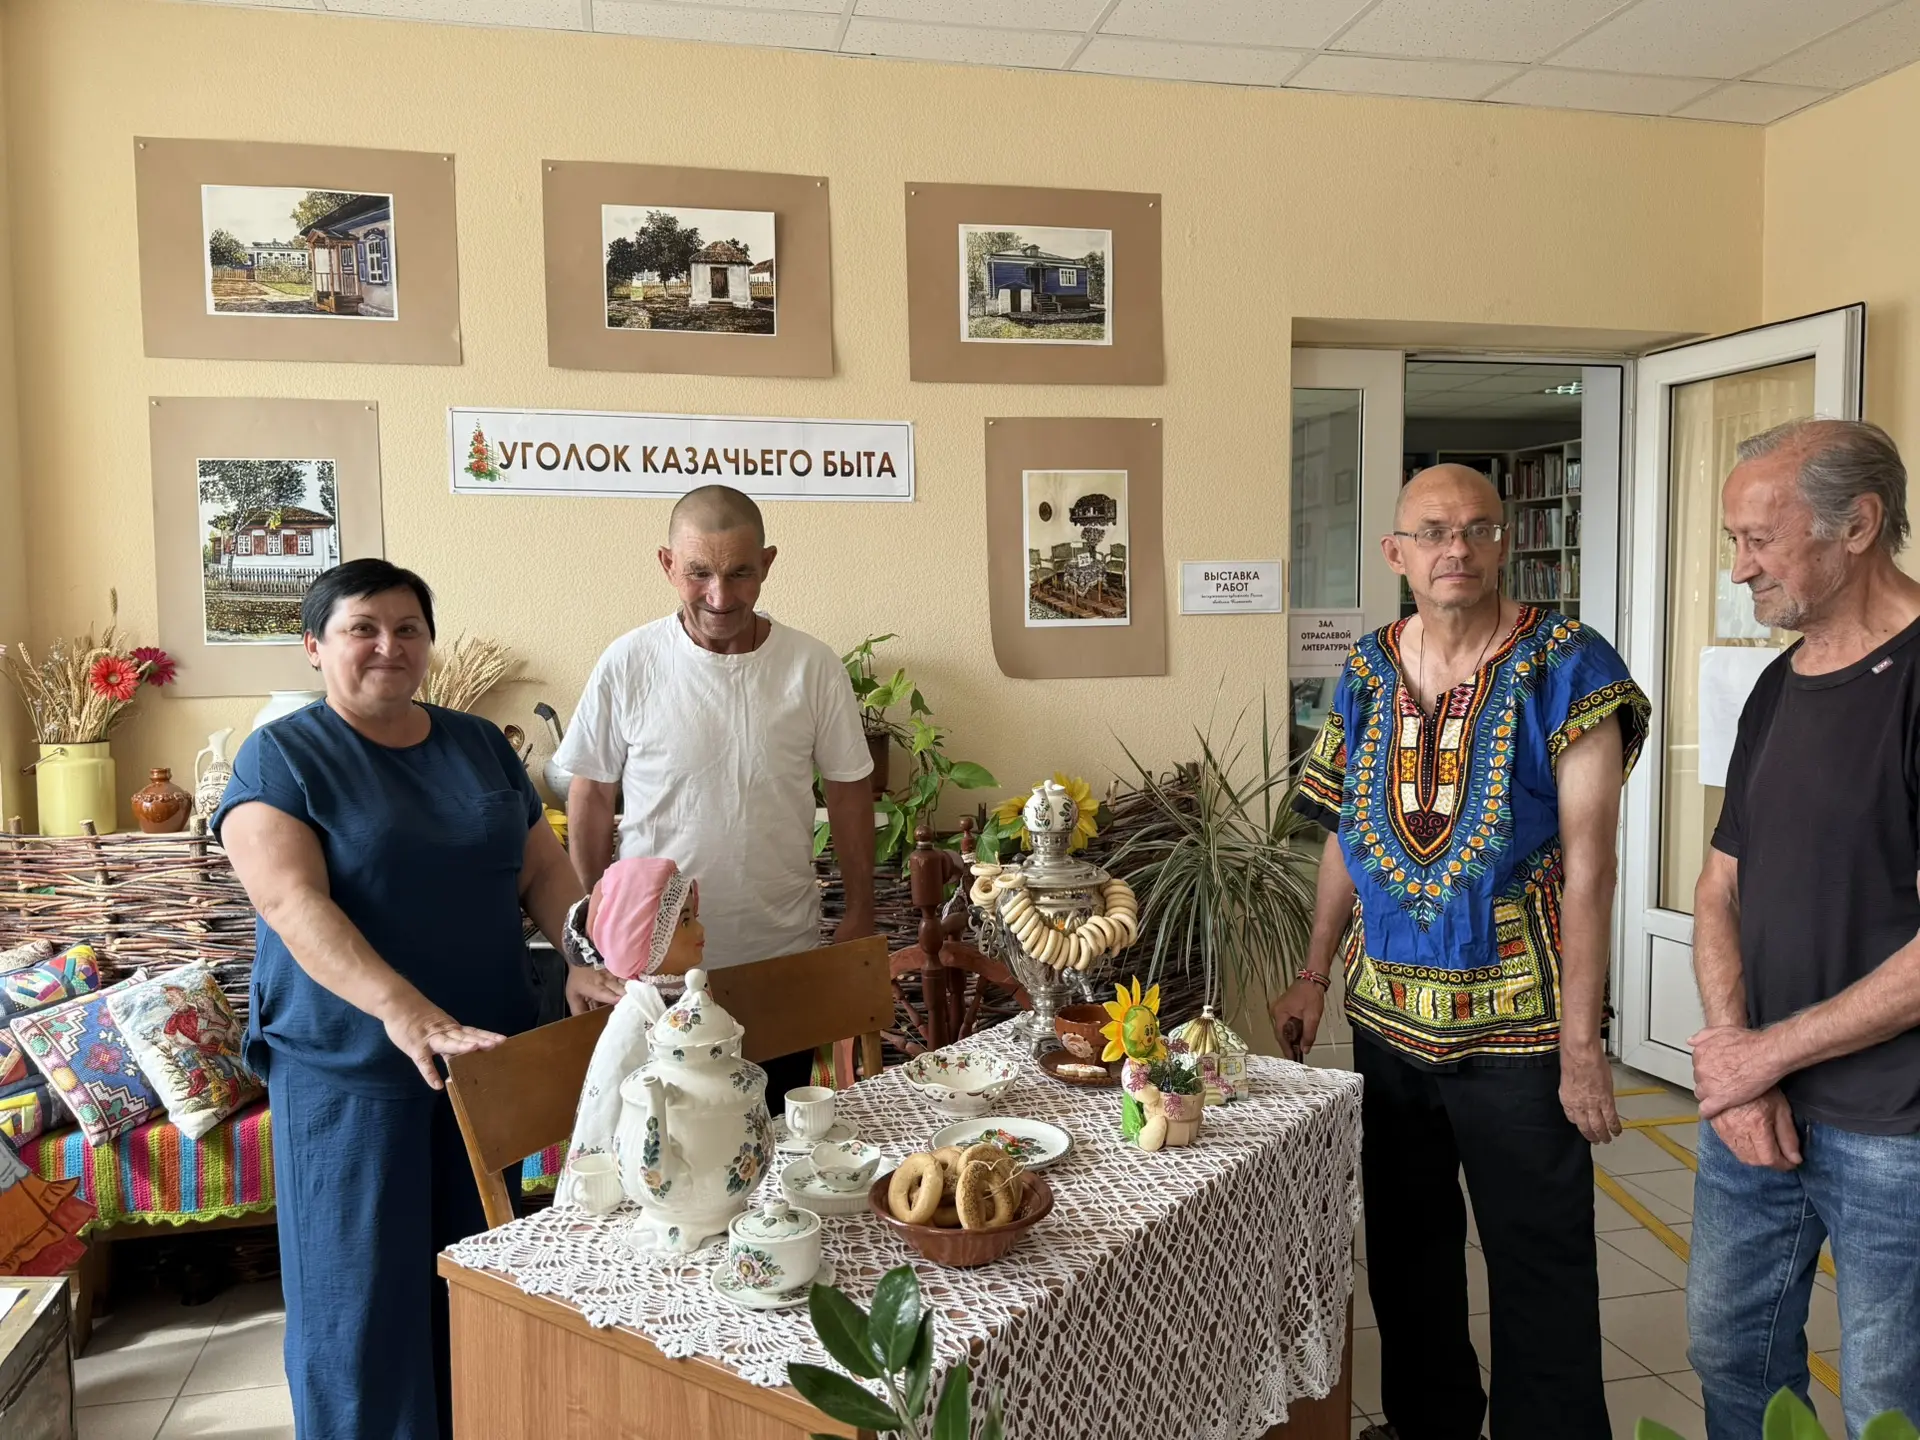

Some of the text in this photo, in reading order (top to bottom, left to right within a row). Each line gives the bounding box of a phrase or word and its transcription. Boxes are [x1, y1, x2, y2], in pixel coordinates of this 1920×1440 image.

[498, 441, 897, 478] УГОЛОК КАЗАЧЬЕГО БЫТА
[1204, 571, 1260, 581] ВЫСТАВКА
[1216, 582, 1249, 592] РАБОТ
[1318, 620, 1334, 628] ЗАЛ
[1301, 630, 1352, 640] ОТРАСЛЕВОЙ
[1301, 643, 1351, 651] ЛИТЕРАТУРЫ
